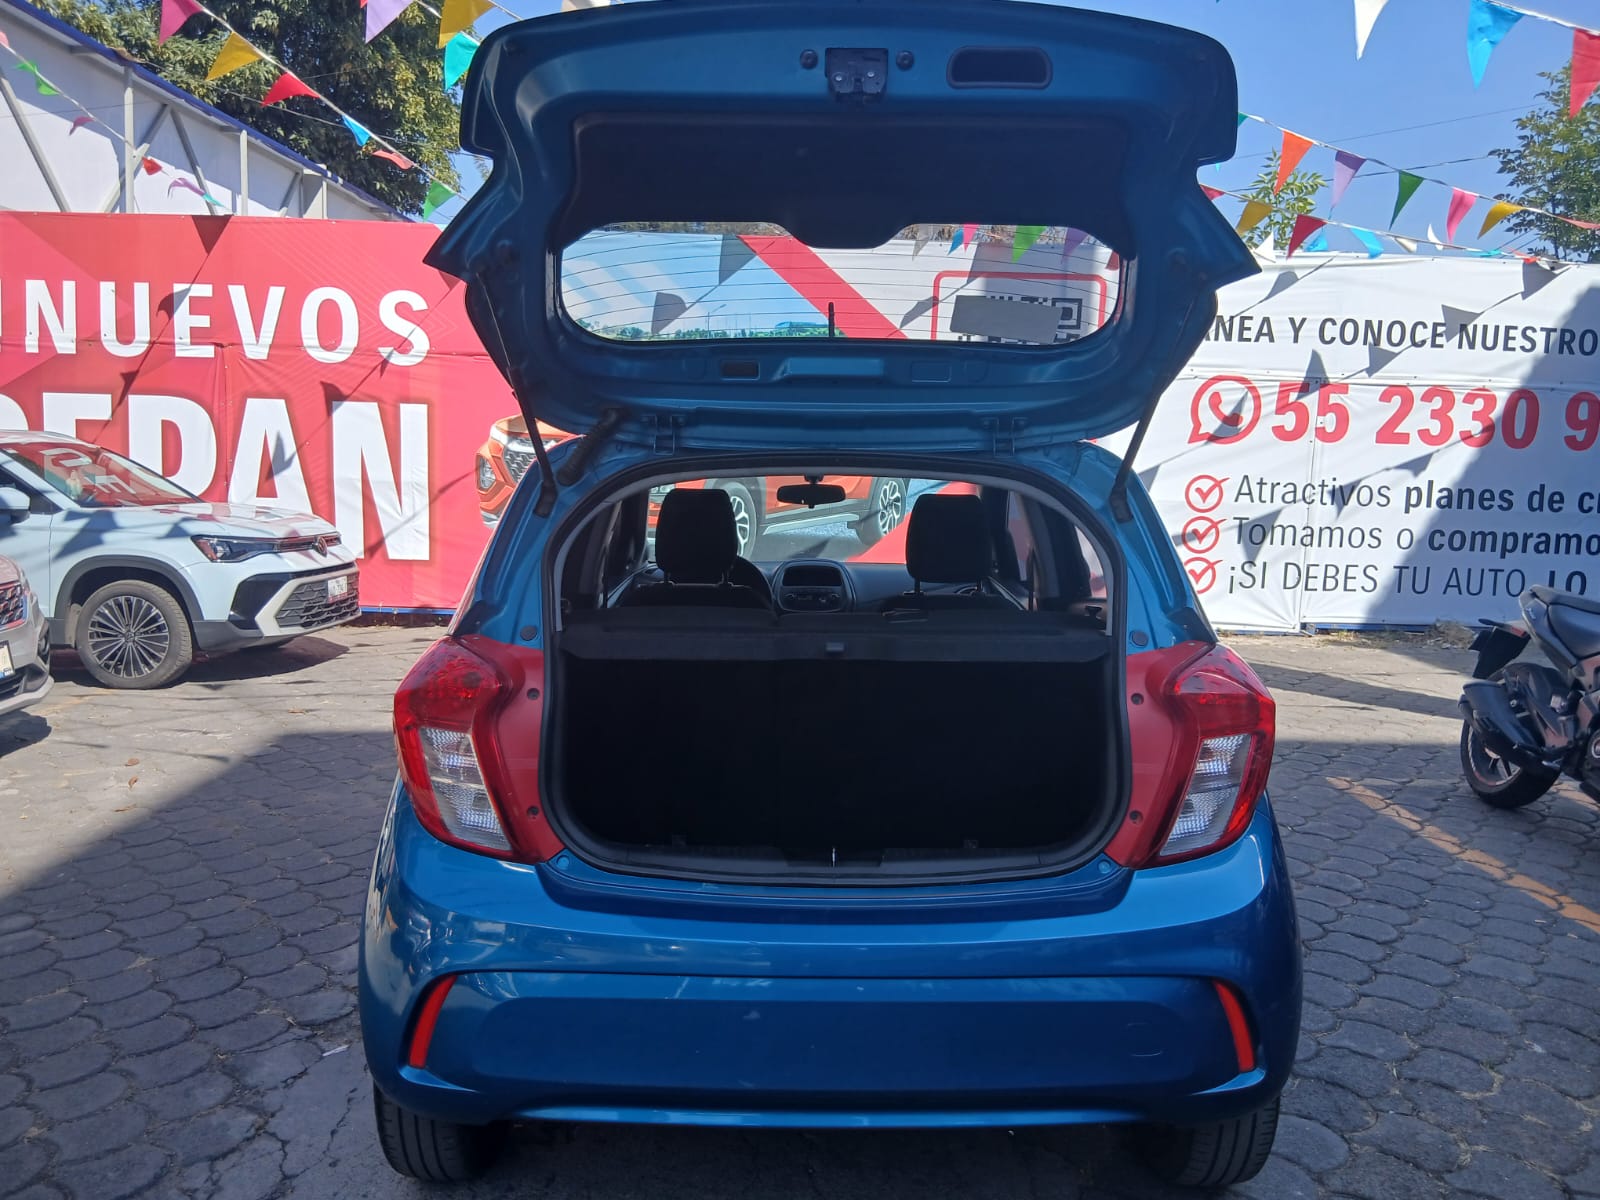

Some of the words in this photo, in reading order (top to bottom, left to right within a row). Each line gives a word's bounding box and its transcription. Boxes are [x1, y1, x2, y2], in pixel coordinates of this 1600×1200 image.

[0, 280, 430, 366] NUEVOS
[1205, 315, 1275, 343] NEA
[1288, 317, 1307, 343] Y
[1318, 317, 1446, 348] CONOCE
[1458, 324, 1598, 356] NUESTRO
[1271, 381, 1350, 443] 55
[1375, 385, 1540, 449] 2330
[1563, 391, 1600, 451] 9
[0, 392, 430, 560] DAN
[1234, 475, 1391, 507] Atractivos
[1404, 480, 1514, 514] planes
[1527, 484, 1565, 512] de
[1577, 491, 1600, 514] c
[1233, 517, 1382, 549] Tomamos
[1396, 528, 1413, 549] o
[1428, 529, 1600, 559] compramo
[1229, 561, 1266, 593] ¡SI
[1283, 562, 1378, 592] DEBES
[1393, 566, 1430, 594] TU
[1442, 567, 1526, 597] AUTO
